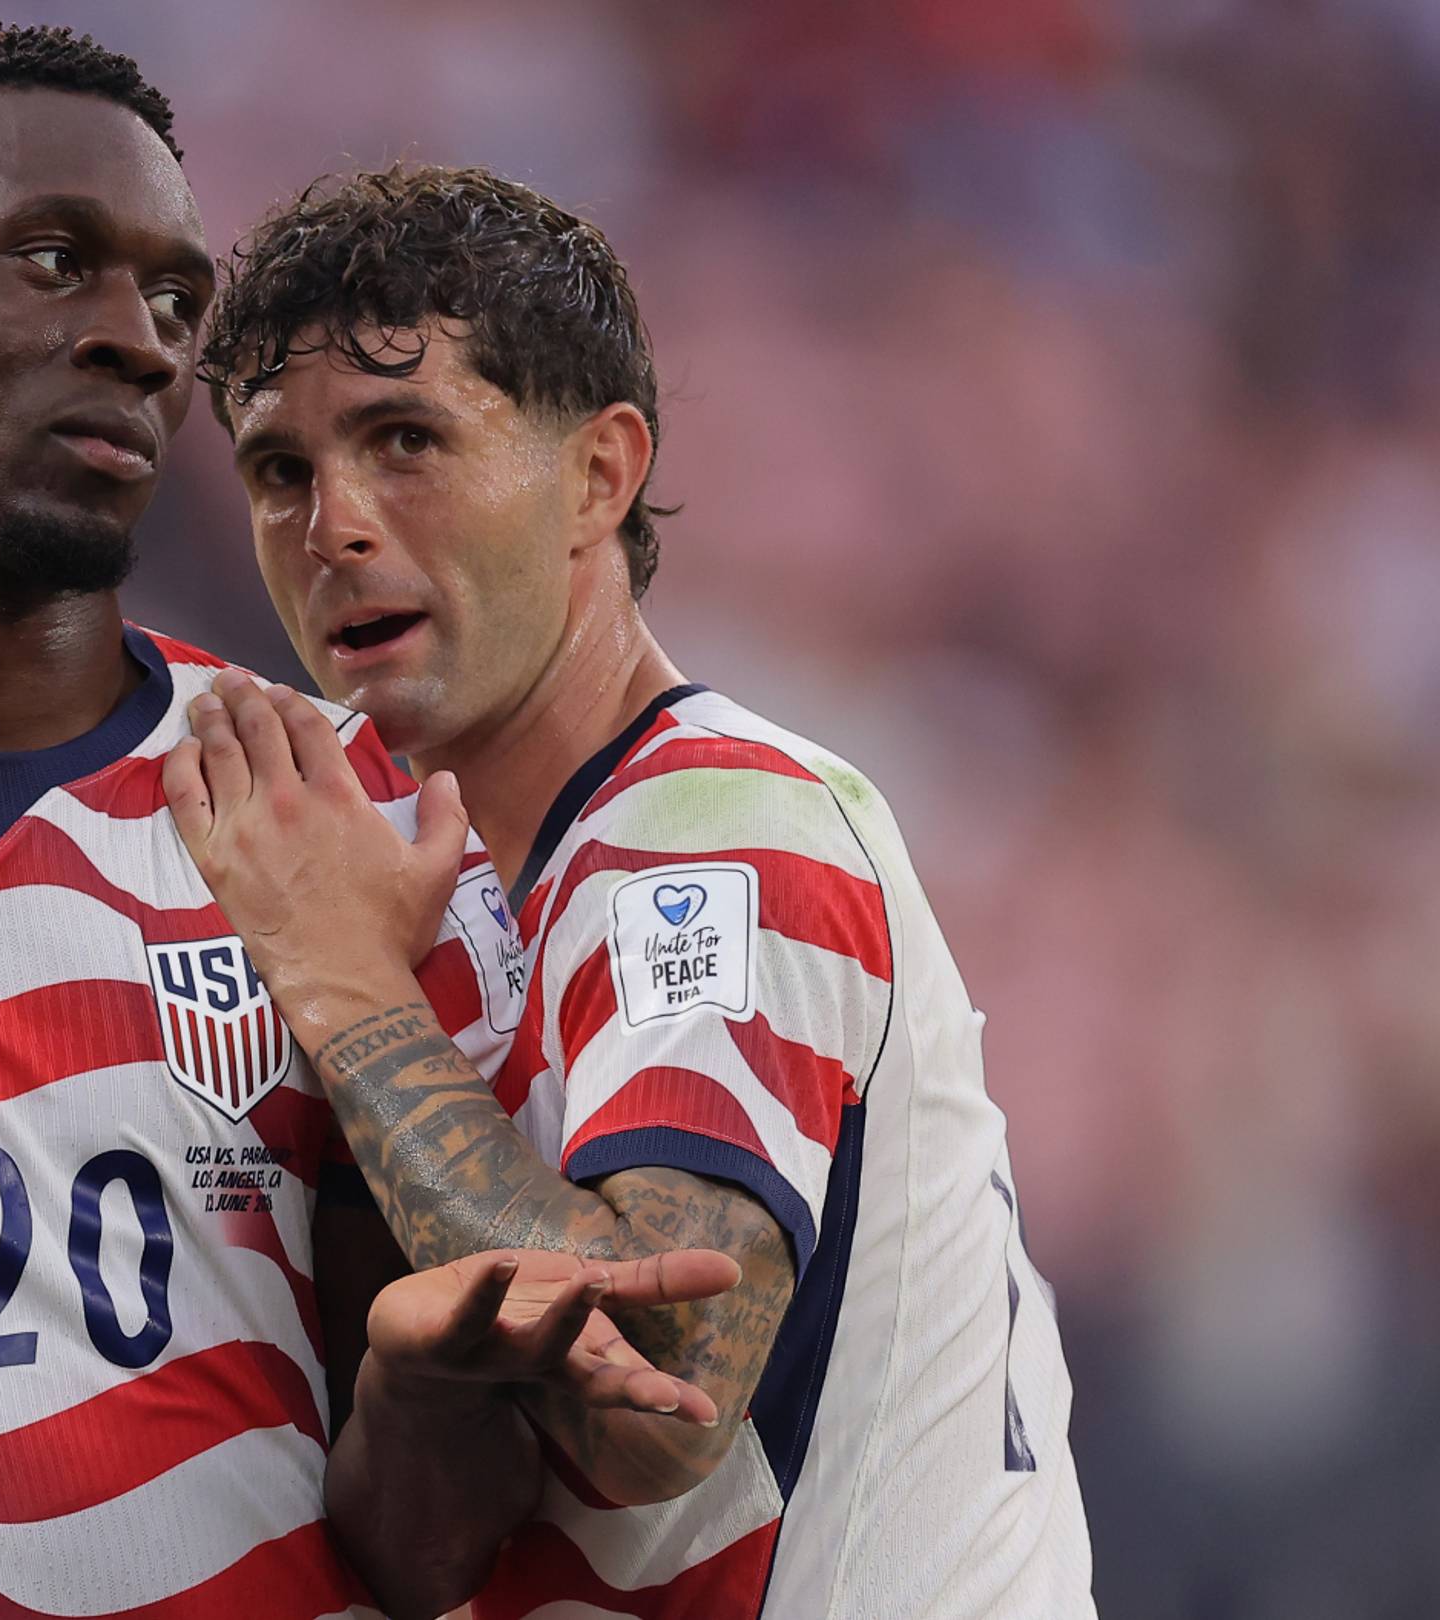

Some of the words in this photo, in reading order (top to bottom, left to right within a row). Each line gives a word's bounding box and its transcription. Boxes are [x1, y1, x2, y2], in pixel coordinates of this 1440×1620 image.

[645, 932, 692, 962] Unite
[692, 926, 721, 954] For
[652, 953, 717, 989] PEACE
[667, 986, 701, 1005] FIFA
[185, 1146, 212, 1165] USA
[214, 1148, 235, 1165] VS.
[192, 1170, 213, 1188] LOS
[215, 1194, 252, 1211] JUNE
